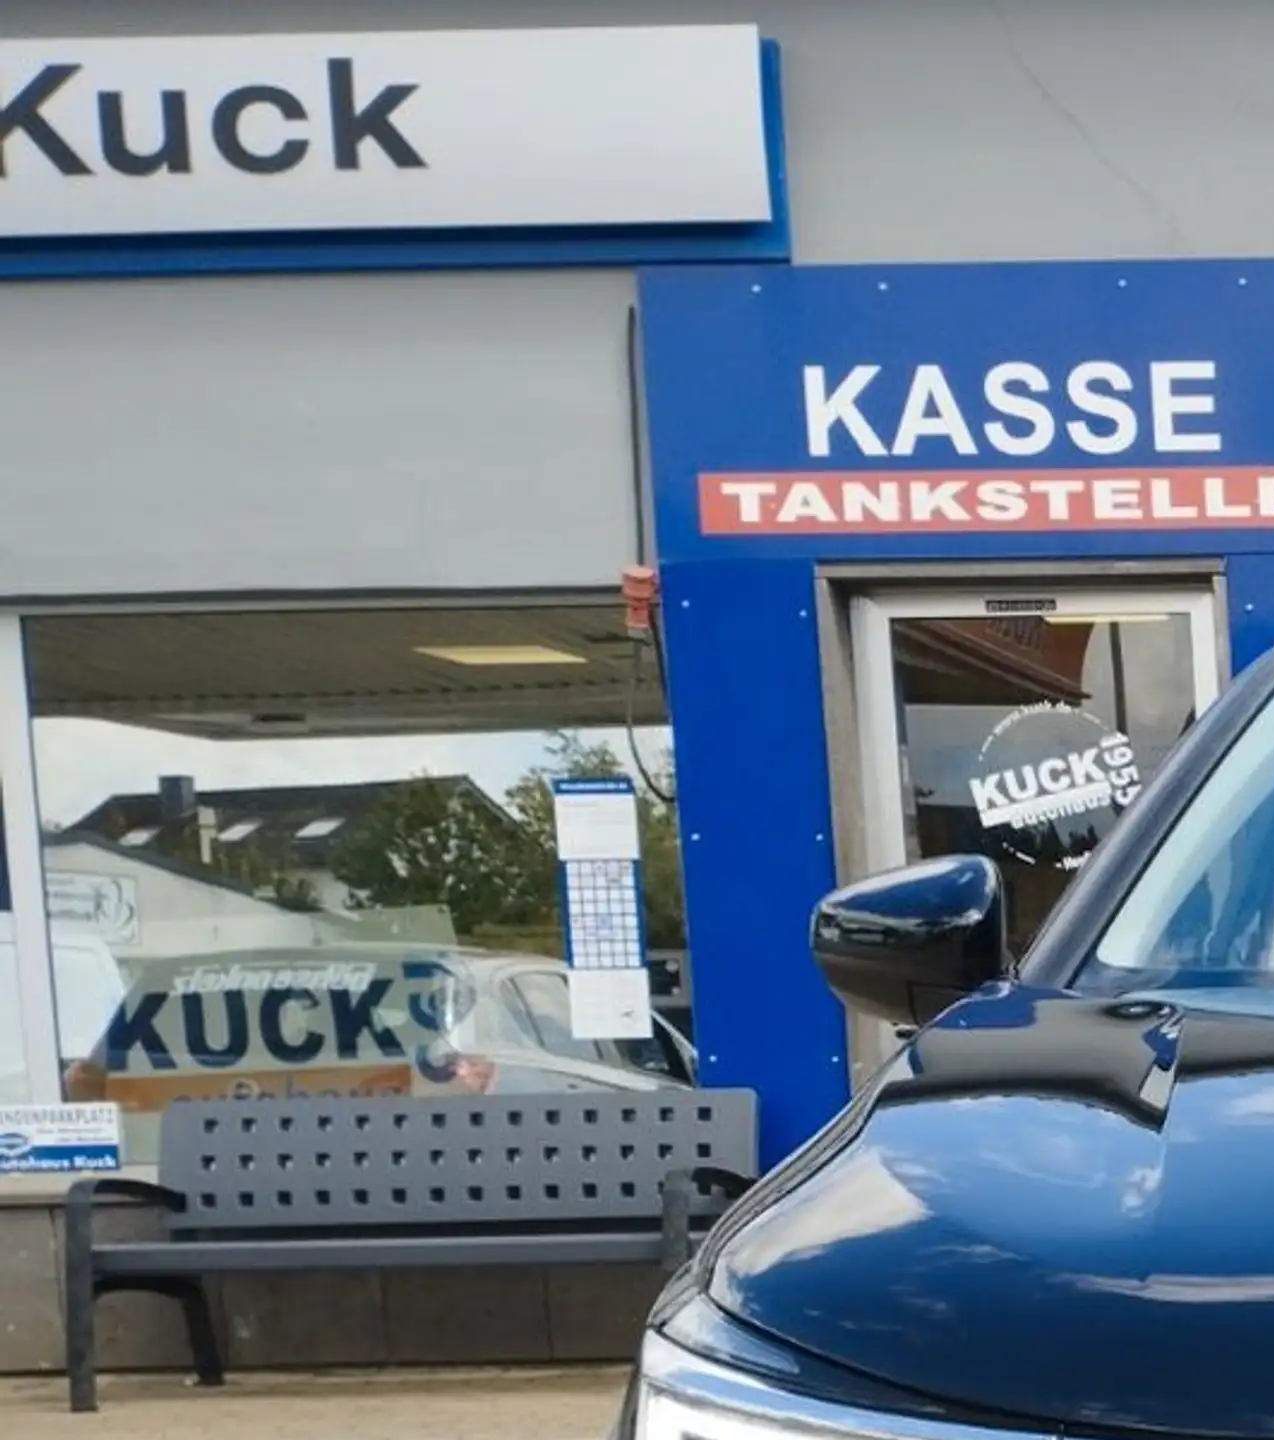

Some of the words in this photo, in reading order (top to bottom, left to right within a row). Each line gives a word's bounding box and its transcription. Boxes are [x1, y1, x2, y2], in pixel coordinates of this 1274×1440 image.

[0, 57, 429, 177] Kuck
[803, 361, 1222, 458] KASSE
[968, 747, 1106, 812] KUCK
[1100, 731, 1142, 807] 1955
[105, 977, 406, 1072] KUCK
